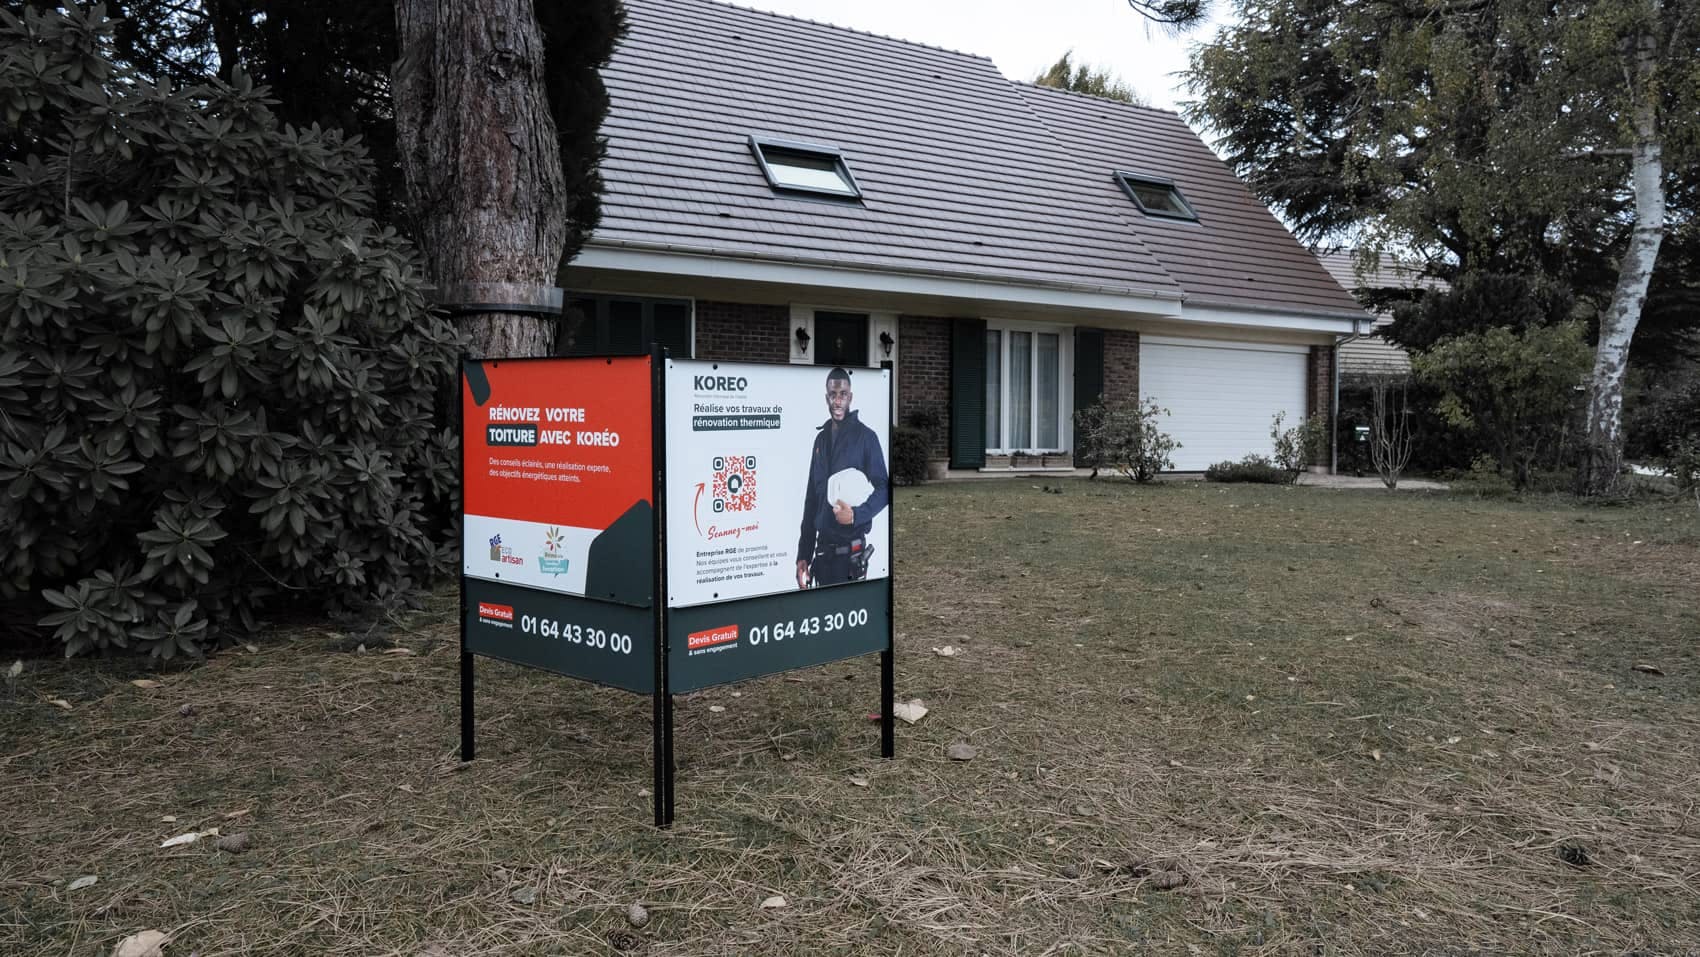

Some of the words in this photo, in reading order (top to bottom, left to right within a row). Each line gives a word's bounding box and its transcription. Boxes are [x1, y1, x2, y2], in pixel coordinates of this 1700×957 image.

[489, 404, 540, 421] RÉNOVEZ
[545, 408, 585, 422] VOTRE
[694, 403, 724, 413] Réalise
[726, 405, 740, 413] vos
[742, 405, 771, 413] travaux
[772, 404, 782, 413] de
[693, 417, 738, 427] rénovation
[740, 417, 780, 429] thermique
[489, 428, 535, 443] TOITURE
[539, 430, 571, 445] AVEC
[576, 428, 620, 447] KORÉO
[489, 457, 499, 466] Des
[500, 458, 521, 467] conseils
[522, 459, 544, 469] éclairés,
[556, 461, 586, 472] réalisation
[489, 469, 499, 477] des
[499, 469, 521, 479] objectifs
[522, 470, 557, 481] énergétiques
[707, 520, 759, 540] Scannez-moi
[489, 533, 502, 546] RGE
[502, 554, 524, 565] artisan
[696, 549, 724, 558] Entreprise
[743, 553, 770, 561] conseillent
[696, 566, 735, 575] accompagnent
[696, 576, 725, 584] réalisation
[480, 605, 494, 615] Devis
[494, 608, 513, 620] Gratuit
[749, 625, 768, 645] 01
[773, 621, 795, 641] 64
[799, 617, 820, 636] 43
[824, 612, 844, 632] 30
[848, 608, 868, 628] 00
[521, 615, 537, 634] 01
[540, 619, 559, 639] 64
[562, 624, 582, 644] 43
[586, 628, 606, 648] 30
[610, 633, 632, 655] 00
[689, 635, 710, 645] Devis
[711, 630, 737, 641] Gratuit
